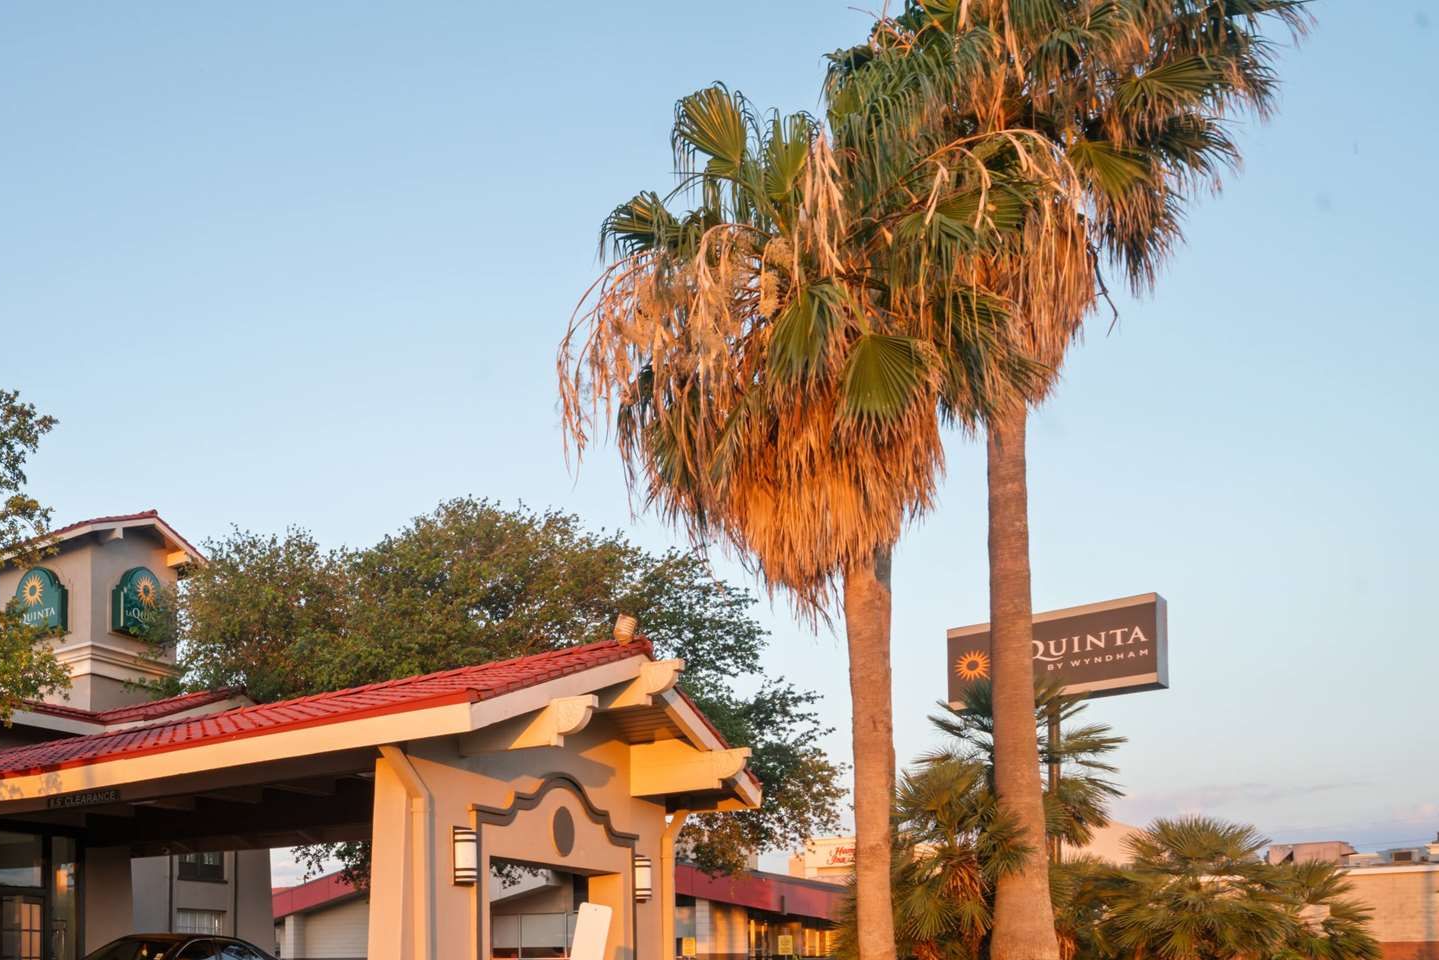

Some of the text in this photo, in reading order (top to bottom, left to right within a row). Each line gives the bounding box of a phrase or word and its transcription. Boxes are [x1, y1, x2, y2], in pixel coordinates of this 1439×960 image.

[1031, 625, 1149, 662] QUINTA
[1047, 648, 1149, 671] BY WYNDHAM
[64, 790, 116, 808] CLEARANCE
